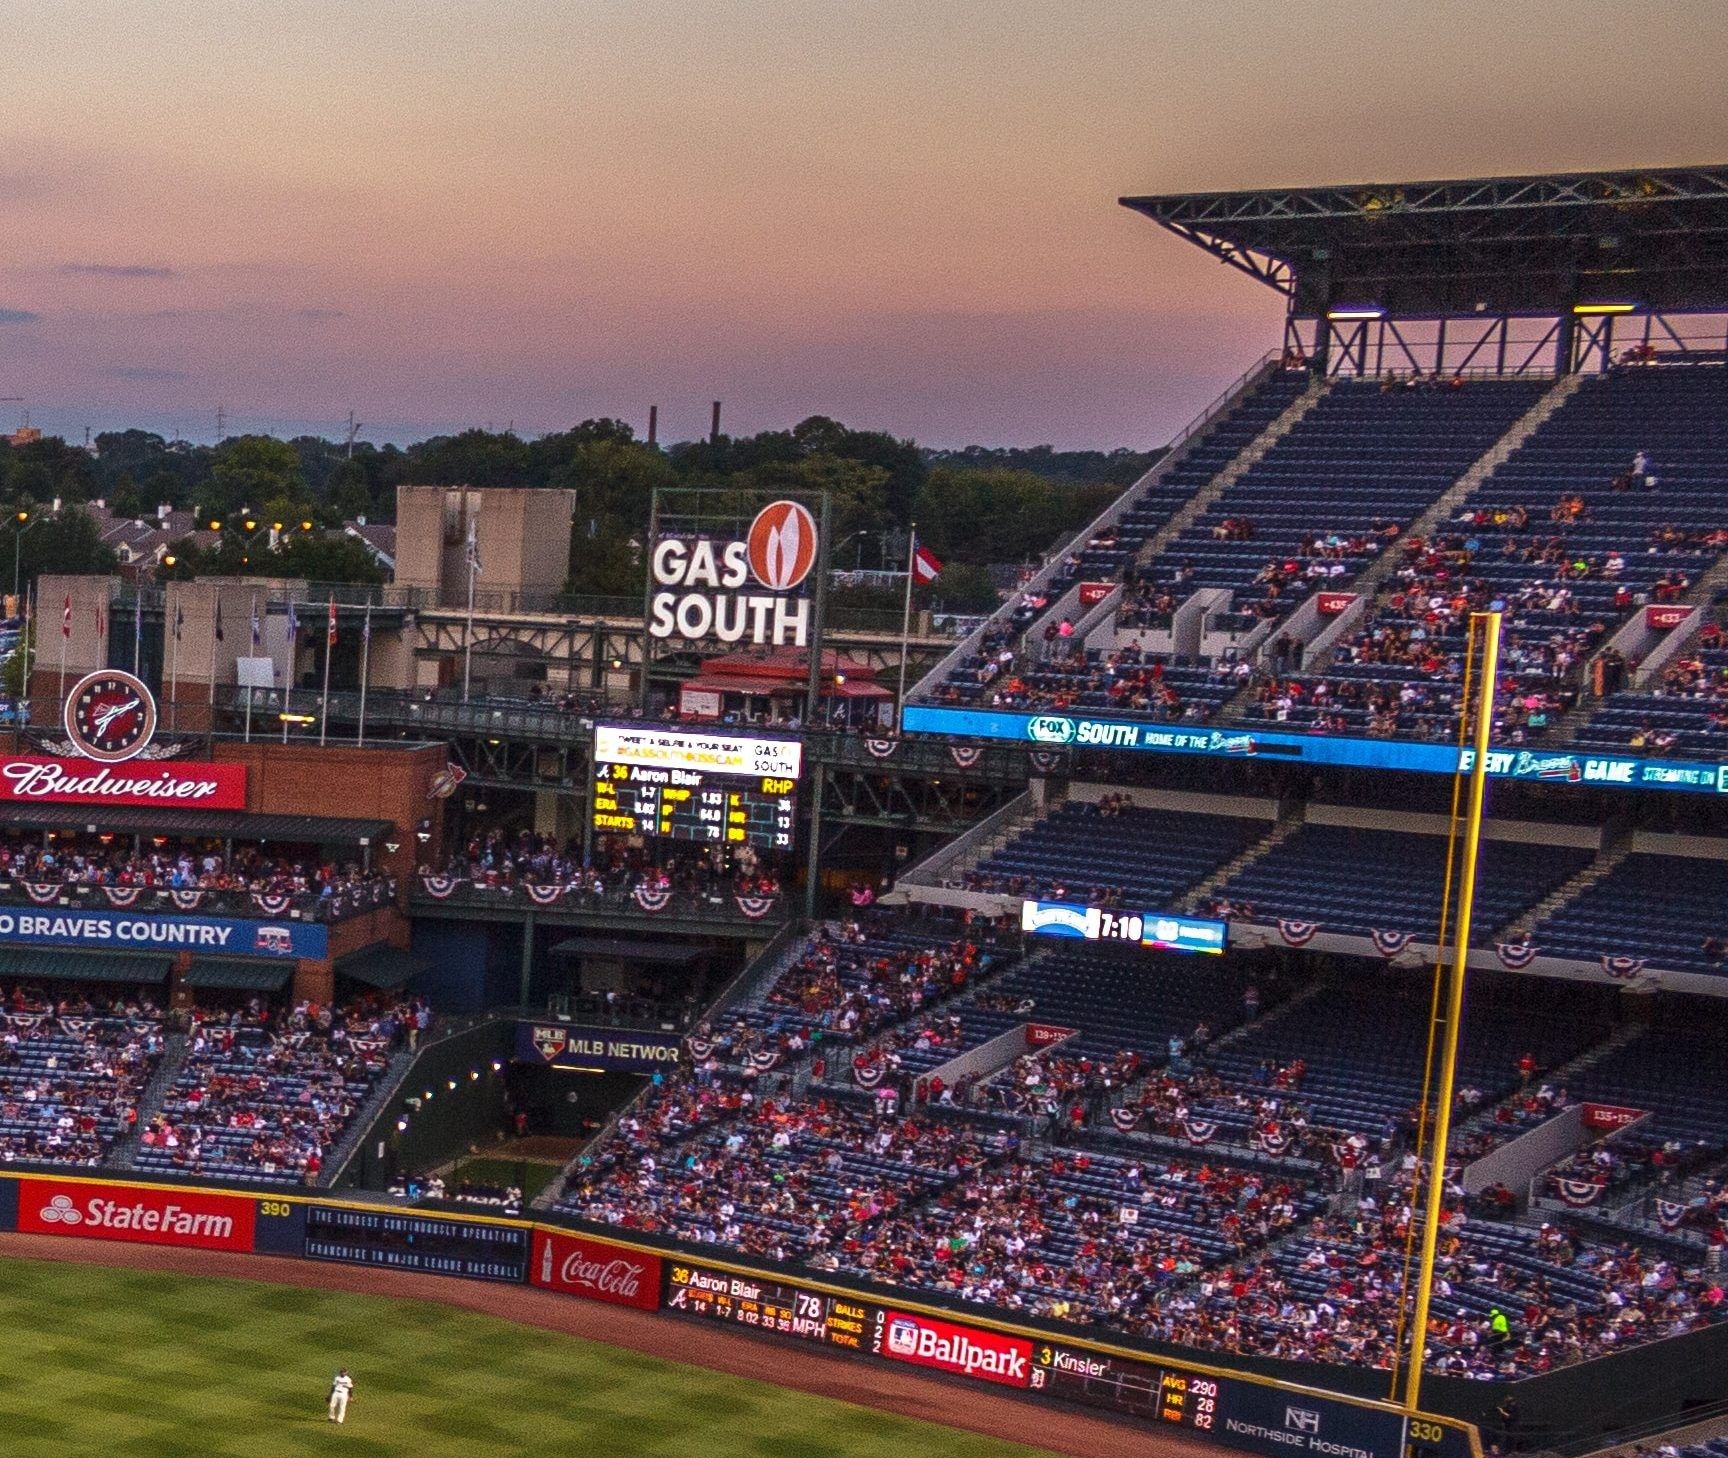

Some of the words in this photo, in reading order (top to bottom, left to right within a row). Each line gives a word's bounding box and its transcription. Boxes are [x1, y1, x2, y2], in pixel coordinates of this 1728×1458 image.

[652, 538, 748, 588] GAS
[650, 592, 809, 647] SOUTH
[1077, 722, 1139, 746] SOUTH
[3, 762, 218, 798] Budweiser
[18, 916, 111, 940] BRAVES
[116, 921, 232, 946] COUNTRY
[1101, 913, 1143, 940] 7:10
[569, 1039, 604, 1055] MLB
[608, 1041, 679, 1062] NETWOR
[85, 1198, 159, 1231] State
[160, 1204, 233, 1238] Farm
[261, 1202, 290, 1217] 390
[561, 1251, 645, 1297] Coca-Cola
[689, 1271, 727, 1293] Aaron
[730, 1279, 761, 1300] Blair
[918, 1330, 1025, 1379] Ballpark
[1041, 1348, 1051, 1365] 3
[1054, 1351, 1106, 1377] Kinsler
[1226, 1419, 1305, 1447] NORTHSIDE
[1410, 1421, 1442, 1443] 330
